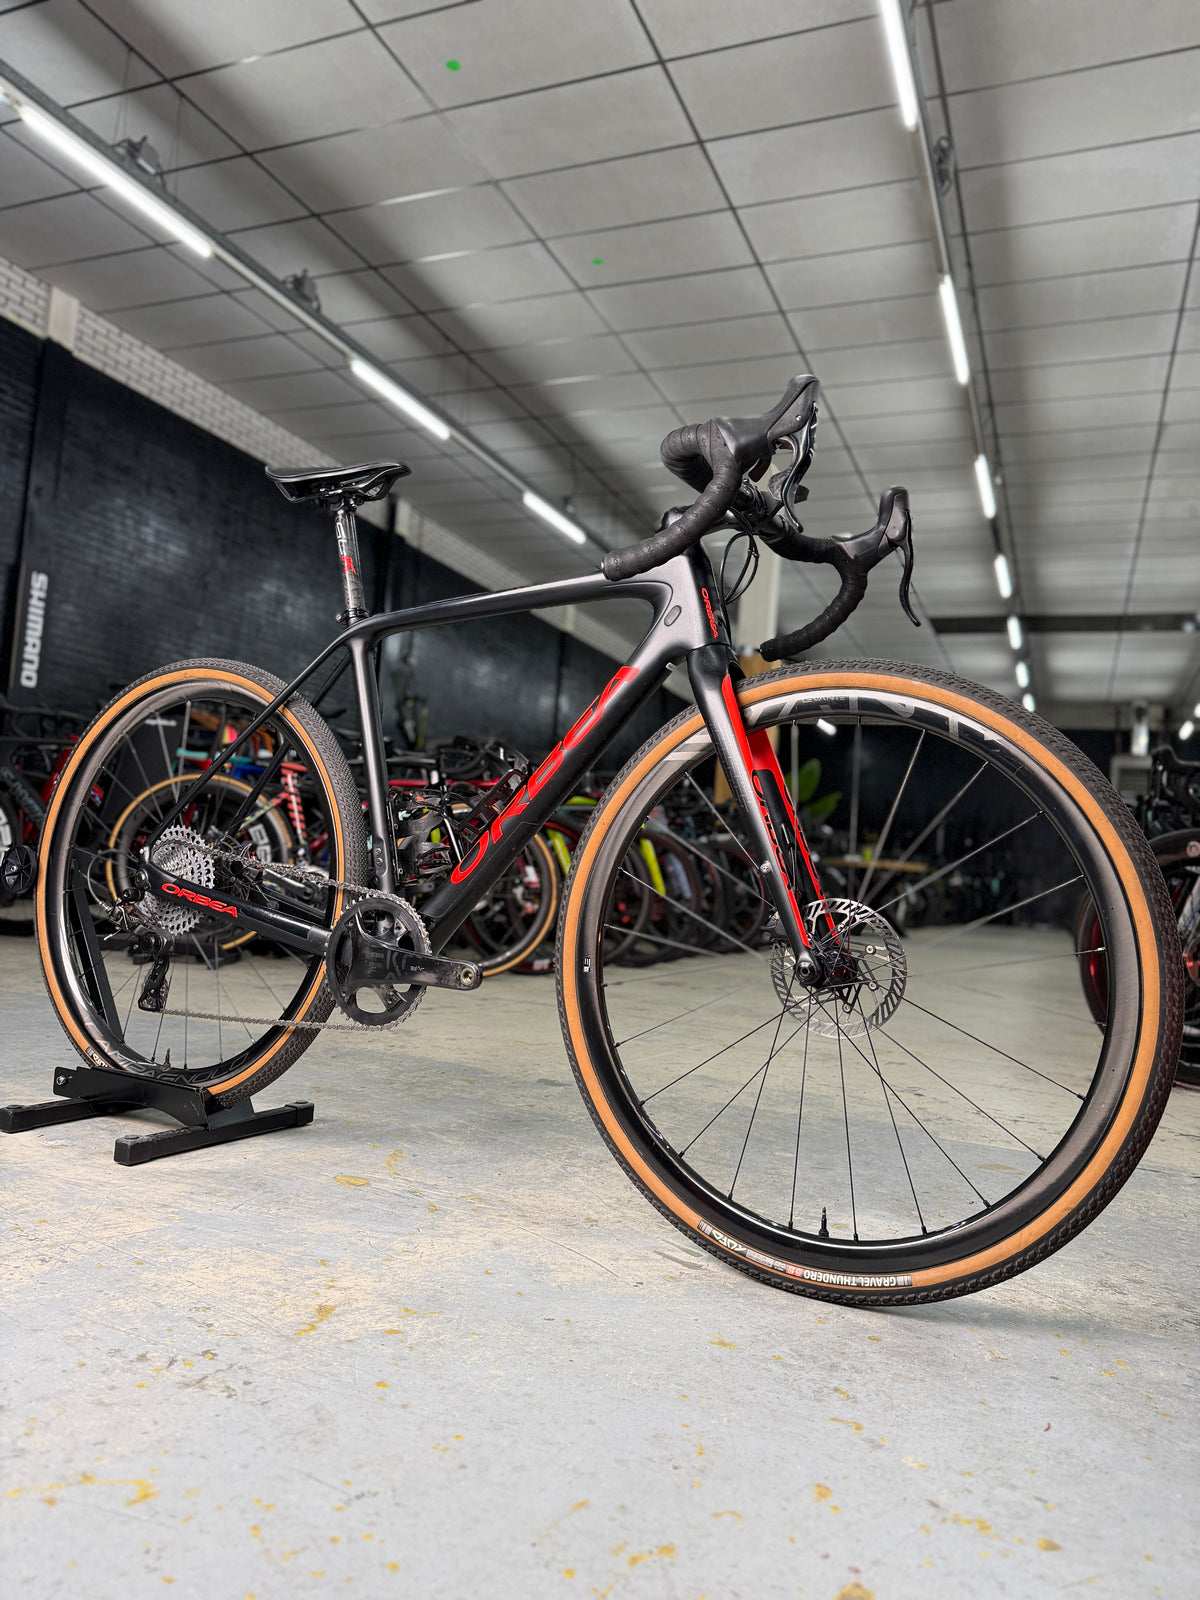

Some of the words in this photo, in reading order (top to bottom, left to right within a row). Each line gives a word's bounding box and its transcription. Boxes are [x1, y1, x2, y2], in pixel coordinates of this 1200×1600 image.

[20, 570, 49, 689] SHIMANO
[701, 587, 719, 639] ORBEA
[450, 665, 641, 885] ORBEA
[161, 882, 238, 918] ORBEA
[803, 1269, 858, 1287] THUNDERO
[859, 1275, 897, 1287] GRAVEL
